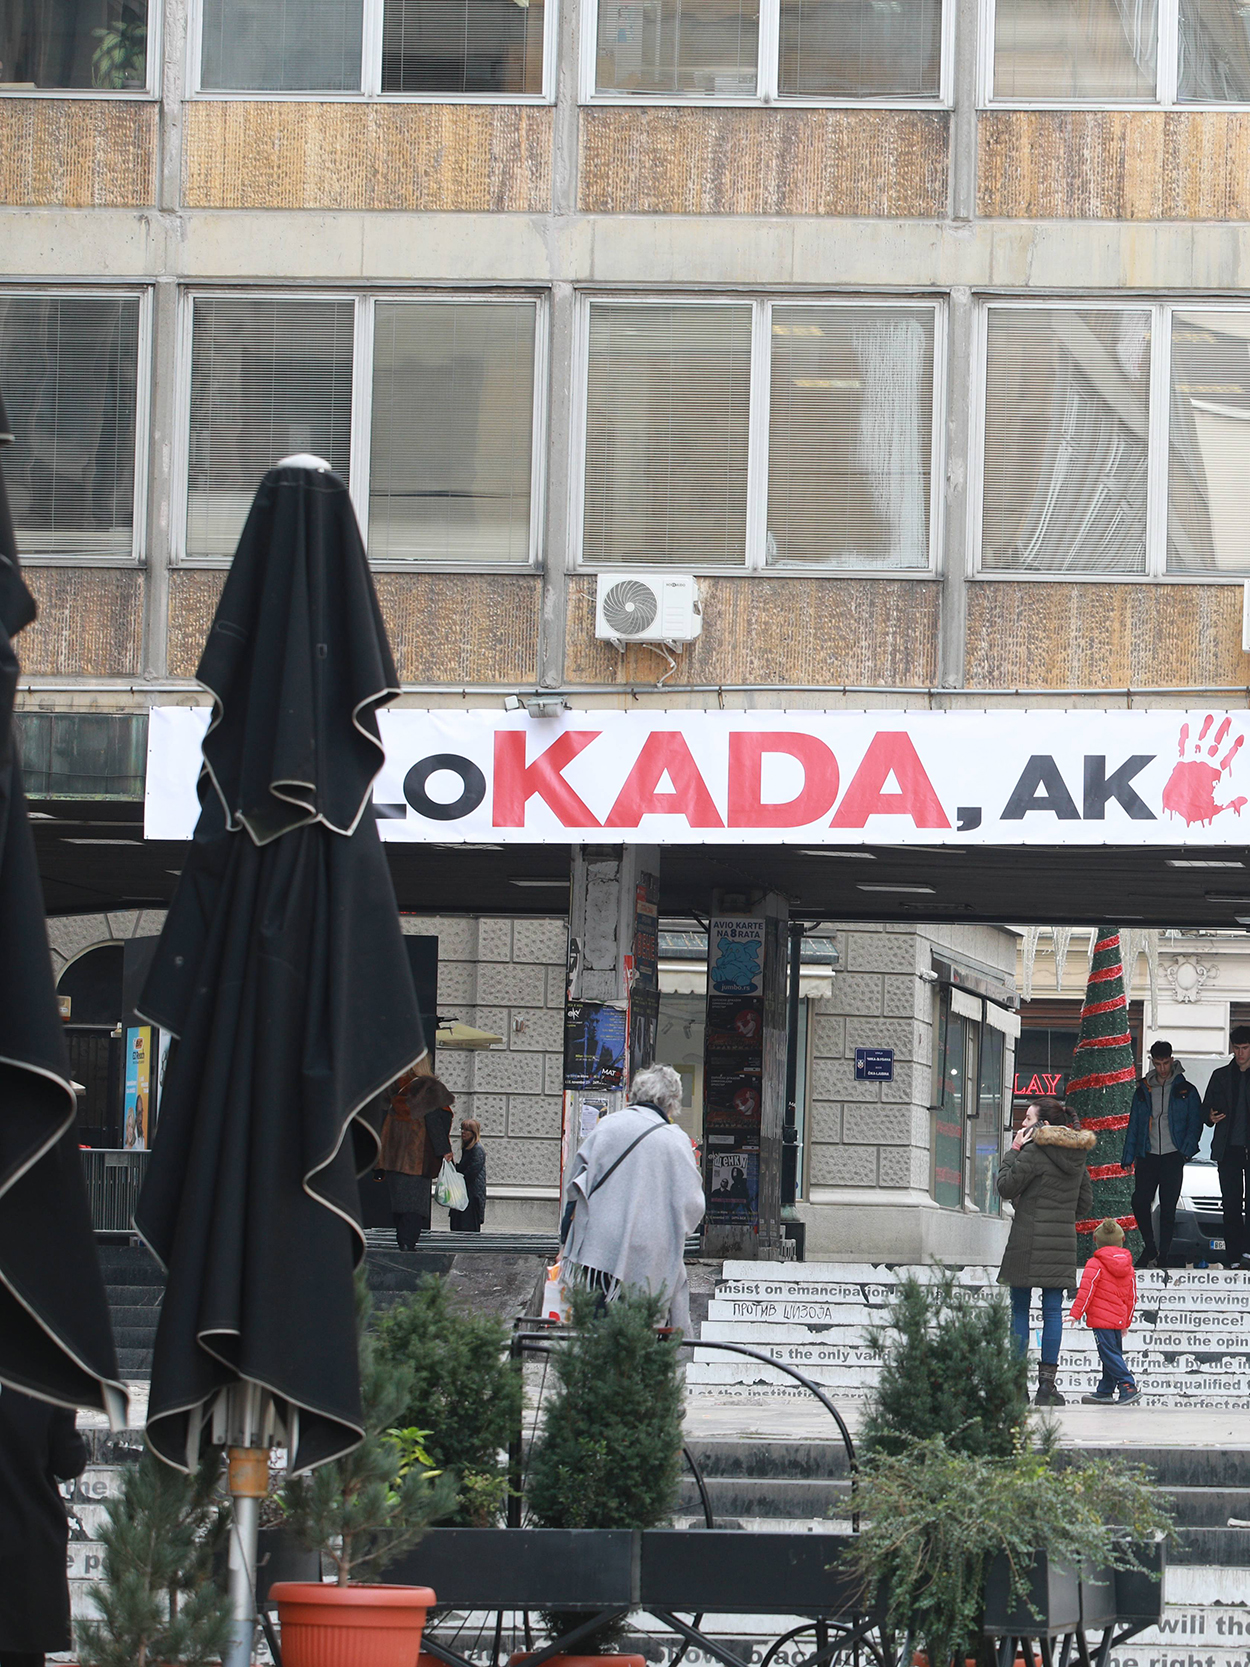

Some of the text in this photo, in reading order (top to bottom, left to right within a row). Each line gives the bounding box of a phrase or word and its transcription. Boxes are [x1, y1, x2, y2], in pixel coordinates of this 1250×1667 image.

[372, 730, 982, 831] OKADA,
[713, 921, 763, 930] AVIO KARTE
[1014, 1073, 1062, 1095] LAY
[1150, 1273, 1173, 1283] the
[1179, 1273, 1219, 1284] circle
[1224, 1273, 1239, 1284] of
[765, 1285, 782, 1295] on
[788, 1284, 890, 1299] emancipaion
[1136, 1294, 1185, 1304] tween
[1191, 1294, 1249, 1307] viewing
[1157, 1313, 1244, 1327] ntelligence!
[1143, 1335, 1181, 1346] Undo
[1187, 1335, 1211, 1346] the
[770, 1348, 783, 1359] Is
[789, 1349, 812, 1359] the
[818, 1349, 849, 1362] only
[1060, 1355, 1091, 1366] hich
[1125, 1357, 1180, 1369] ffirmed
[1209, 1358, 1232, 1369] the
[1030, 1375, 1063, 1386] Wo
[1069, 1376, 1082, 1386] is
[1087, 1376, 1100, 1387] th
[1136, 1380, 1170, 1389] rson
[1173, 1379, 1241, 1394] qualified
[1174, 1400, 1250, 1409] perfected
[1158, 1615, 1204, 1634] will
[1109, 1652, 1138, 1667] he
